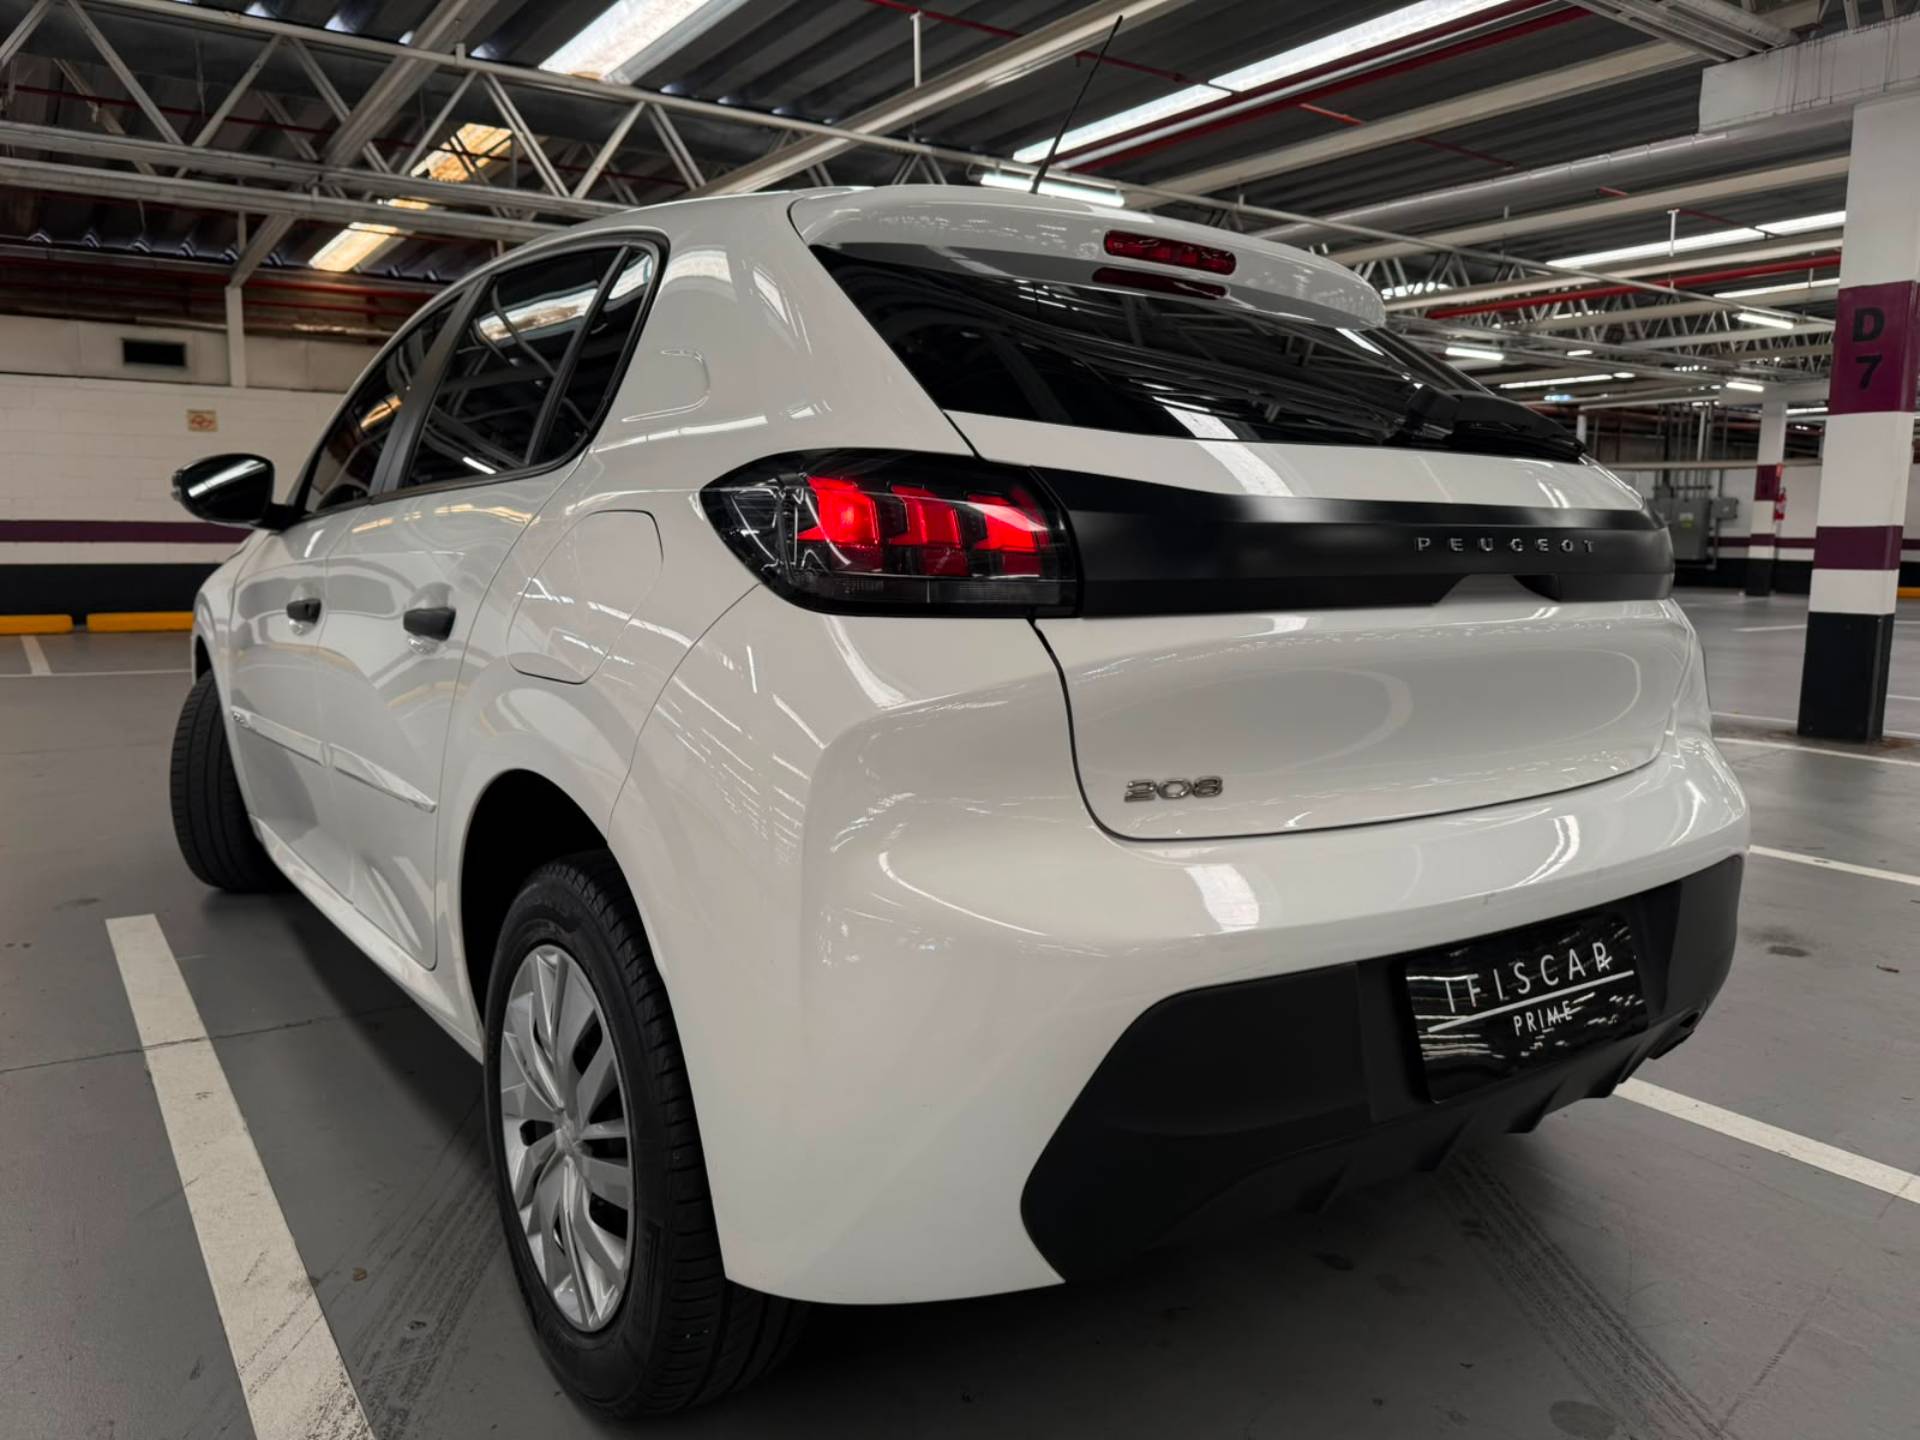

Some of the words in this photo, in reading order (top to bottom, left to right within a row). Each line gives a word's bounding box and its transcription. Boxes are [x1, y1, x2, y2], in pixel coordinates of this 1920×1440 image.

[1853, 308, 1885, 341] D
[1856, 354, 1882, 390] 7
[1415, 537, 1594, 552] PEUGEOT
[1513, 1000, 1573, 1036] PRIME
